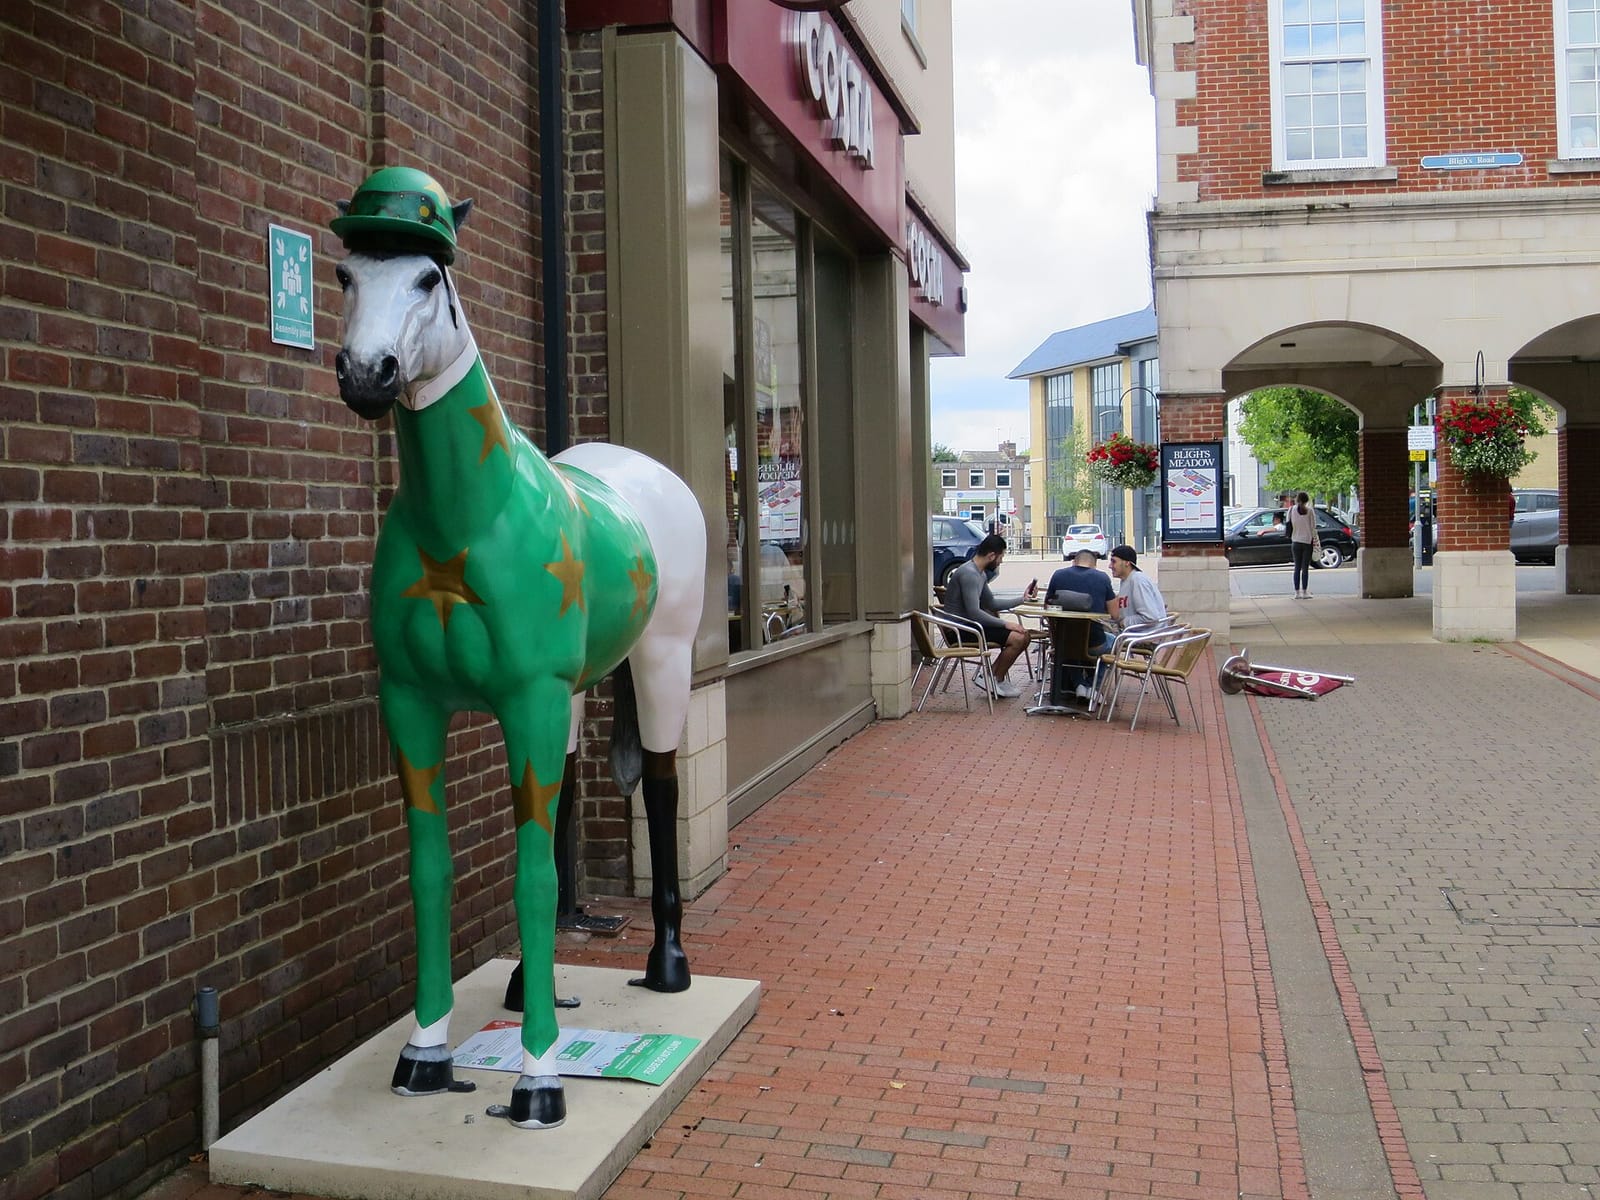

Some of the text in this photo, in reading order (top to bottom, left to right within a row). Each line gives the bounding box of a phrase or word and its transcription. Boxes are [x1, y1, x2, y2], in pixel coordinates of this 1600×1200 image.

[800, 11, 874, 170] COSTA
[1477, 156, 1495, 164] Road
[908, 222, 944, 306] COSTA
[275, 322, 299, 338] Assembly
[1169, 458, 1215, 467] MEADOW
